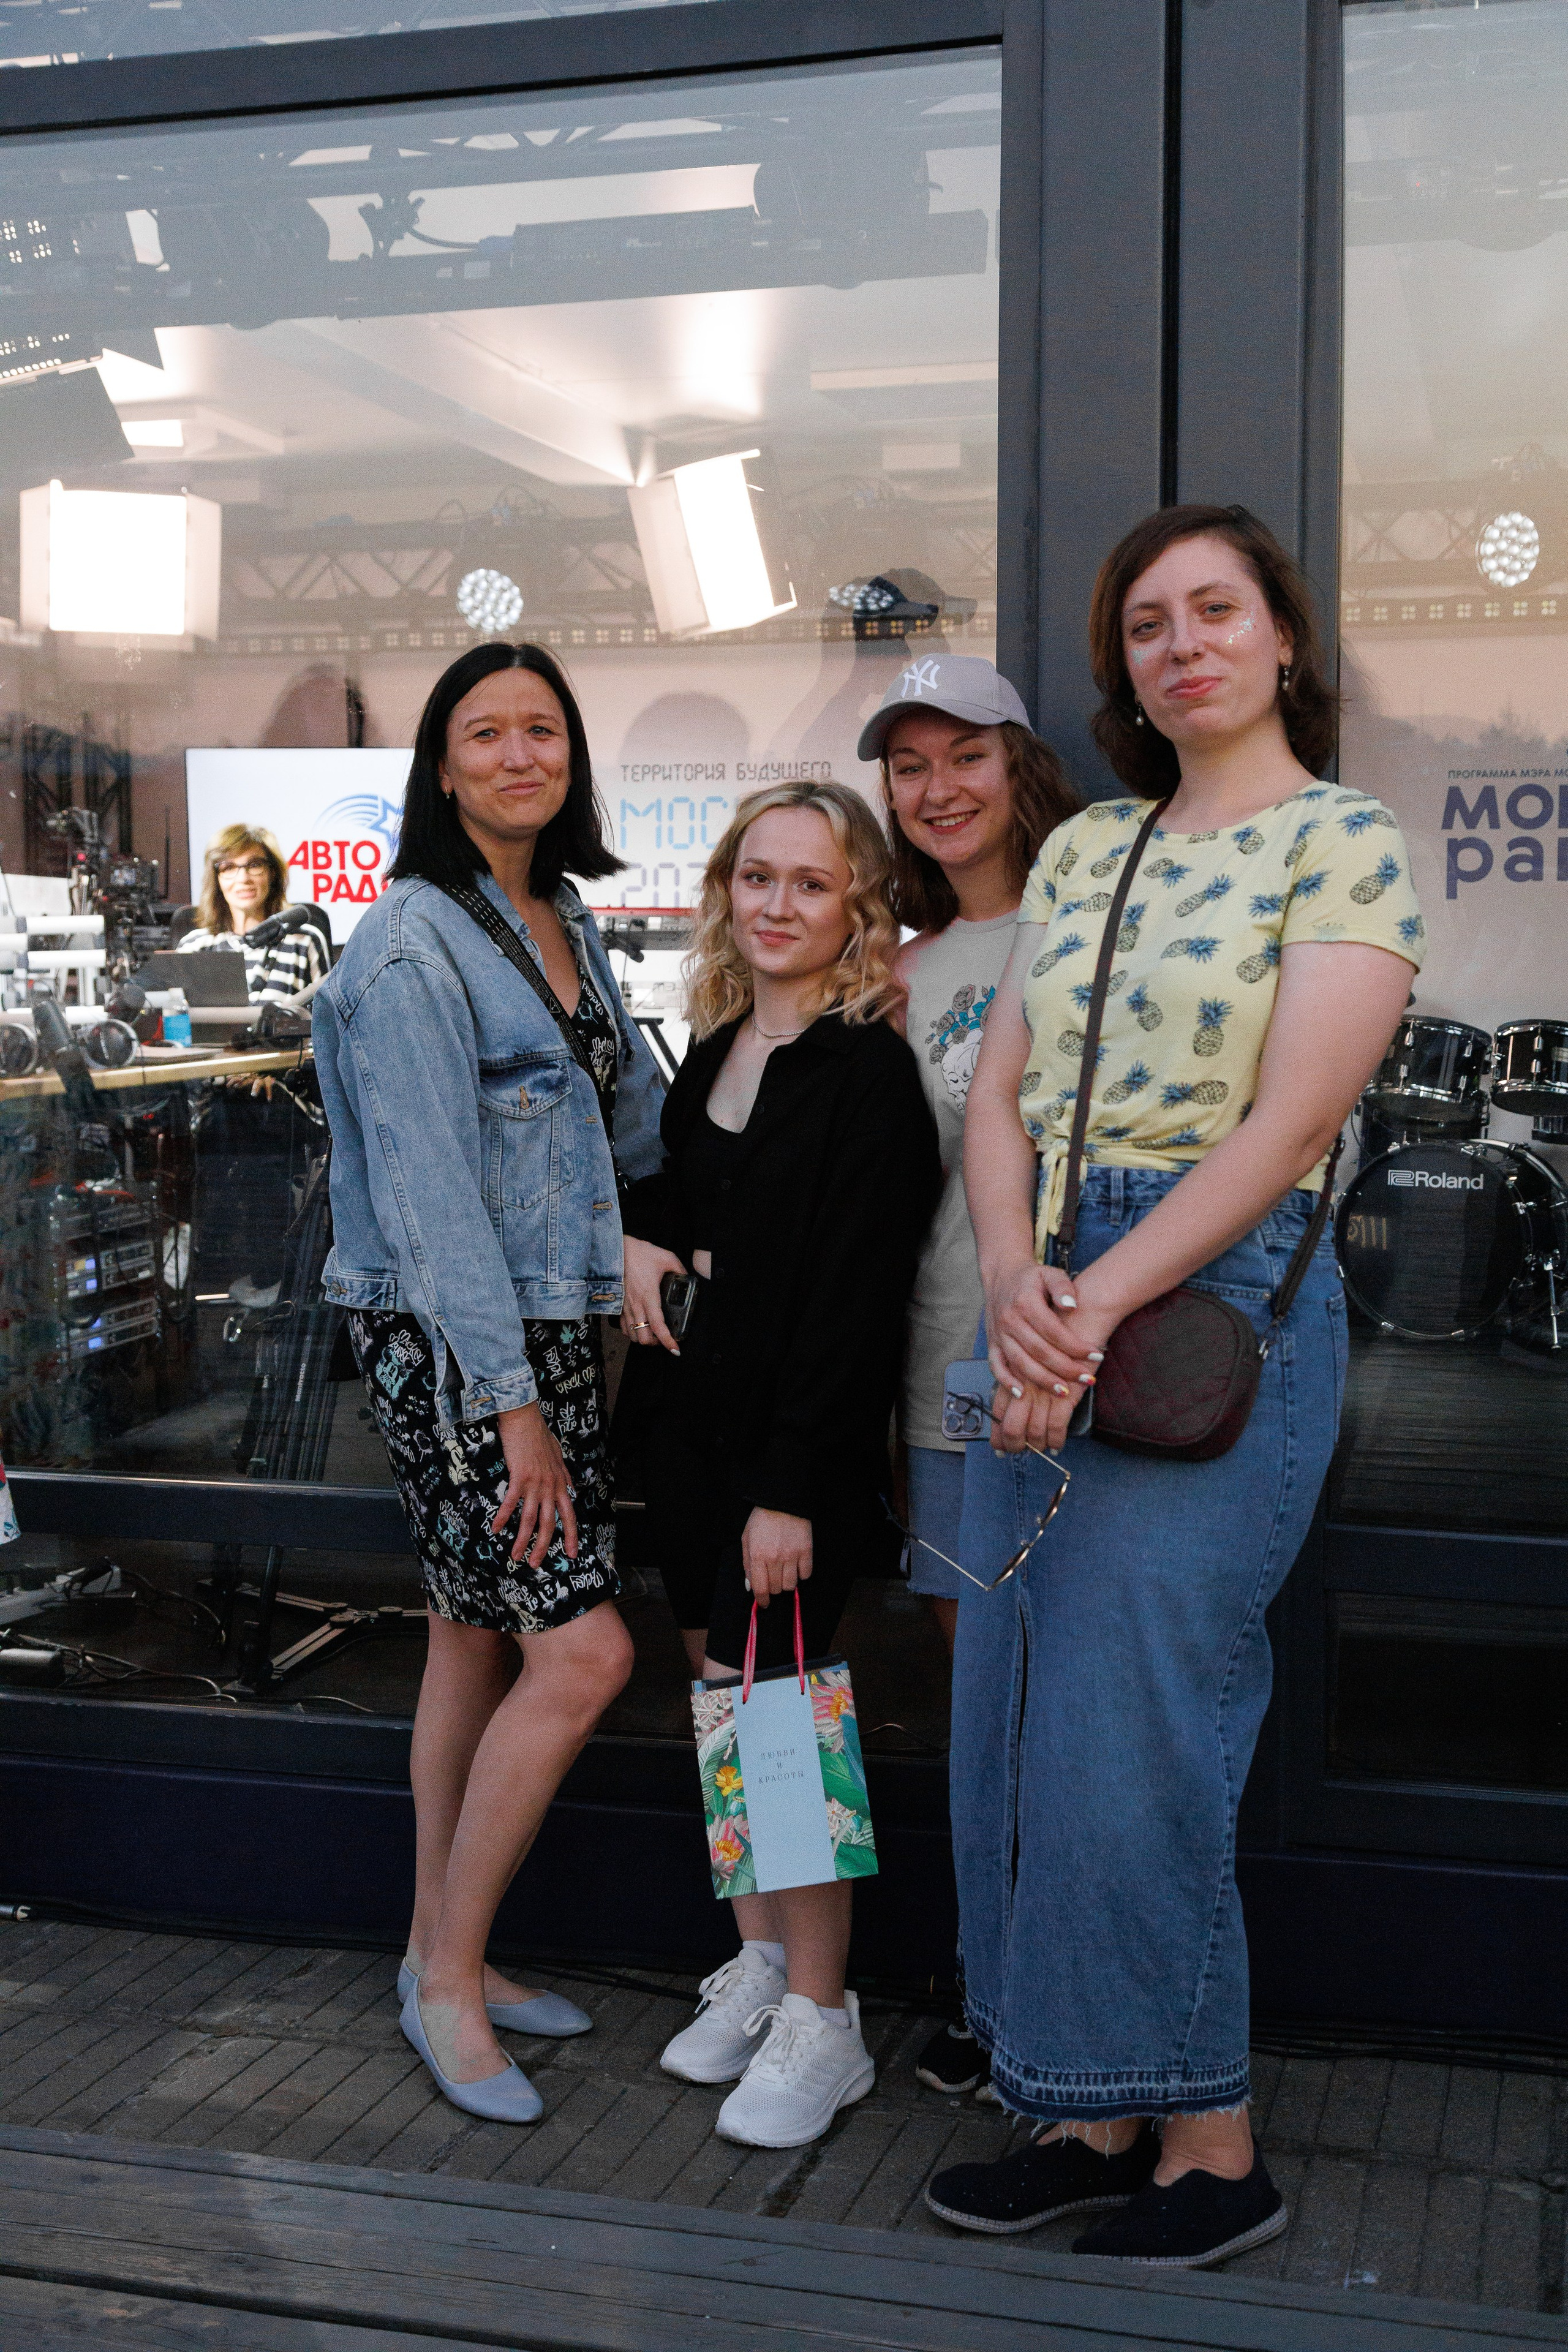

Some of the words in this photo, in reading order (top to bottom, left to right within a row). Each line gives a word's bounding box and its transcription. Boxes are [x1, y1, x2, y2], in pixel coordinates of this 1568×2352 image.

[900, 660, 940, 698] NY
[620, 763, 726, 782] ТЕРРИТОРИЯ
[736, 761, 831, 781] БУДУЩЕГО
[1447, 769, 1517, 778] ПРОГРАММА
[1520, 769, 1551, 777] МЭРА
[288, 840, 381, 870] АВТО
[1446, 836, 1568, 900] ра
[313, 873, 388, 903] РАД
[1415, 1170, 1484, 1189] Roland
[758, 1770, 804, 1784] КРАСОТЫ
